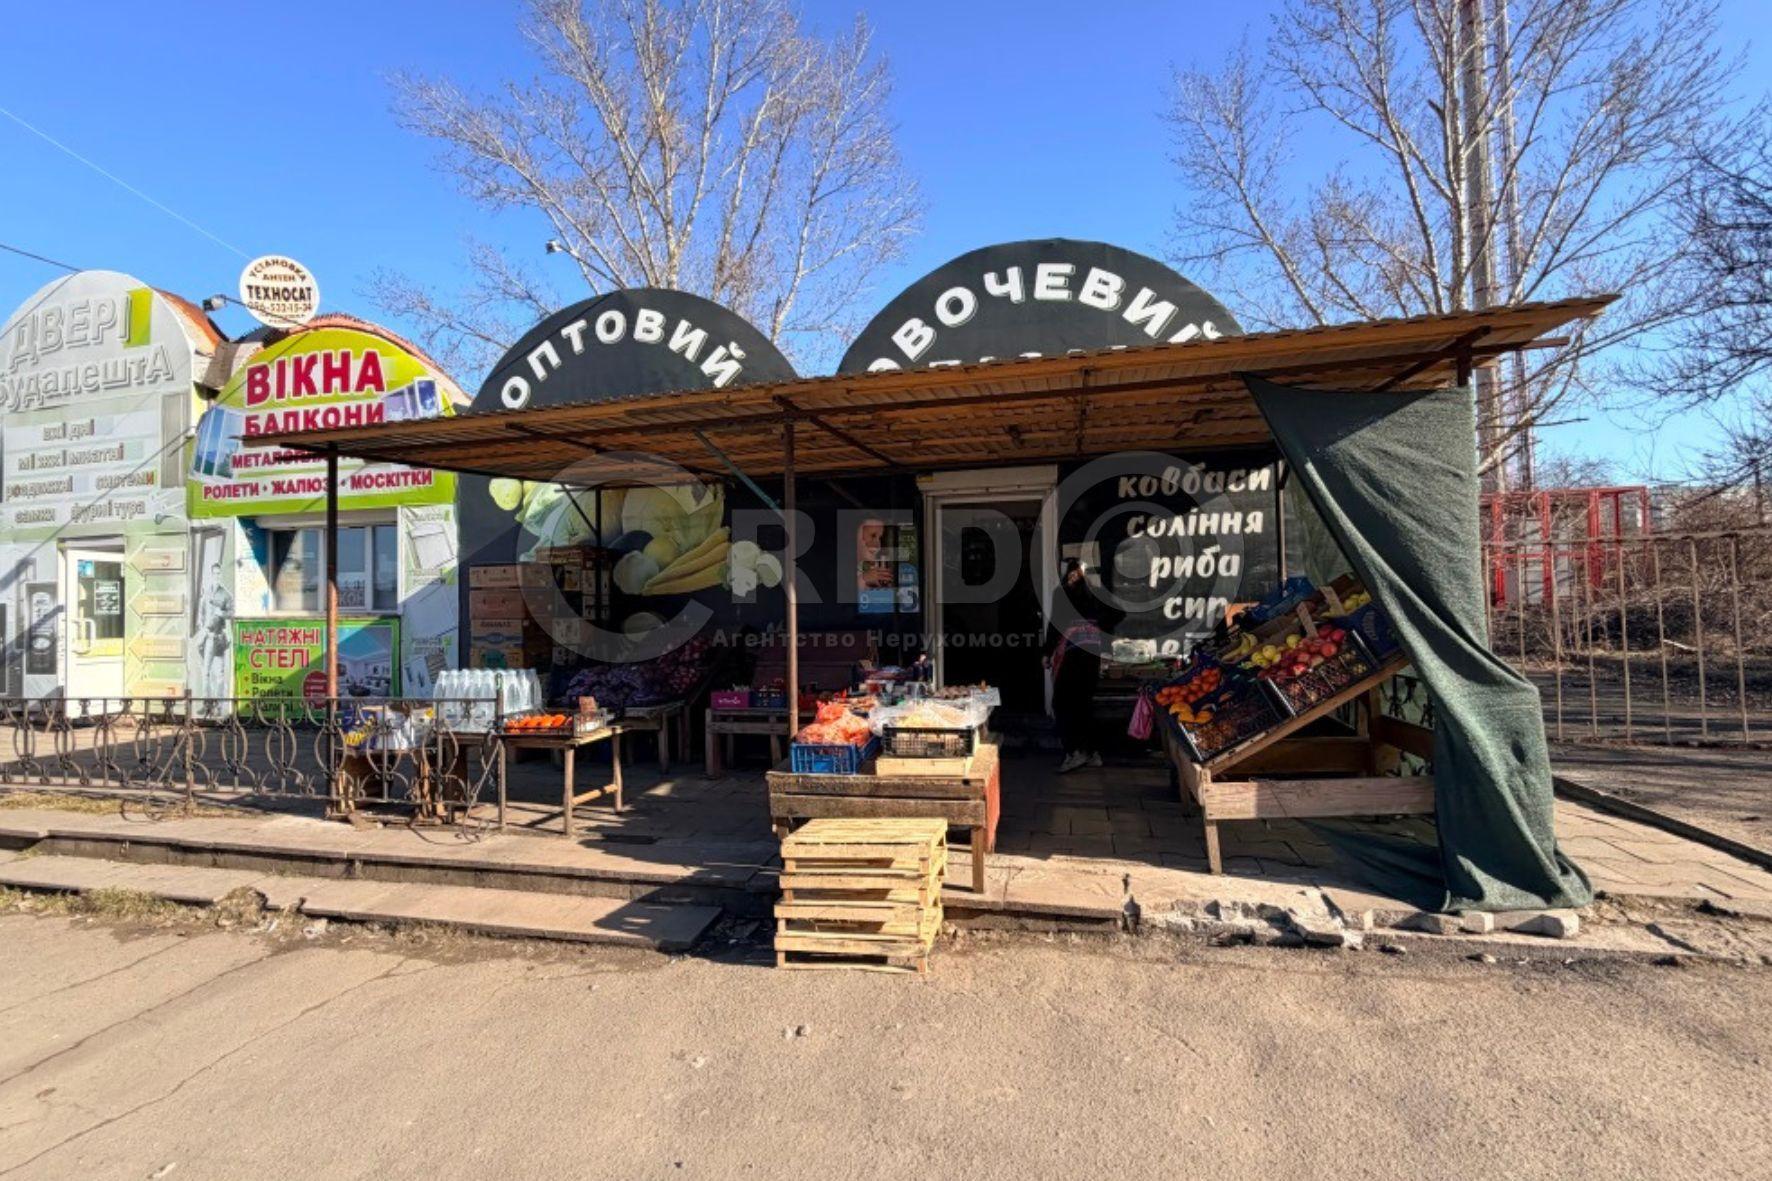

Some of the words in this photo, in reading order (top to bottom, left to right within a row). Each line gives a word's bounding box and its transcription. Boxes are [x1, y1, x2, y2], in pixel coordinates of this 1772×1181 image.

[247, 285, 312, 302] ТЕХНОСАТ
[9, 295, 133, 374] ДВЕРІ
[501, 308, 747, 410] ОПТОВИЙ
[246, 351, 385, 405] ВІКНА
[244, 401, 384, 436] БАЛКОНИ
[203, 481, 260, 499] РОЛЕТИ
[271, 479, 329, 496] ЖАЛЮЗ
[351, 469, 432, 490] МОСКІТКИ
[1118, 462, 1271, 498] ковбаси
[1126, 507, 1263, 538] соління
[1149, 544, 1240, 588] риба
[1163, 597, 1228, 628] сир
[240, 628, 320, 645] НАТЯЖНІ
[250, 648, 310, 669] СТЕЛІ
[251, 672, 284, 685] Вікна
